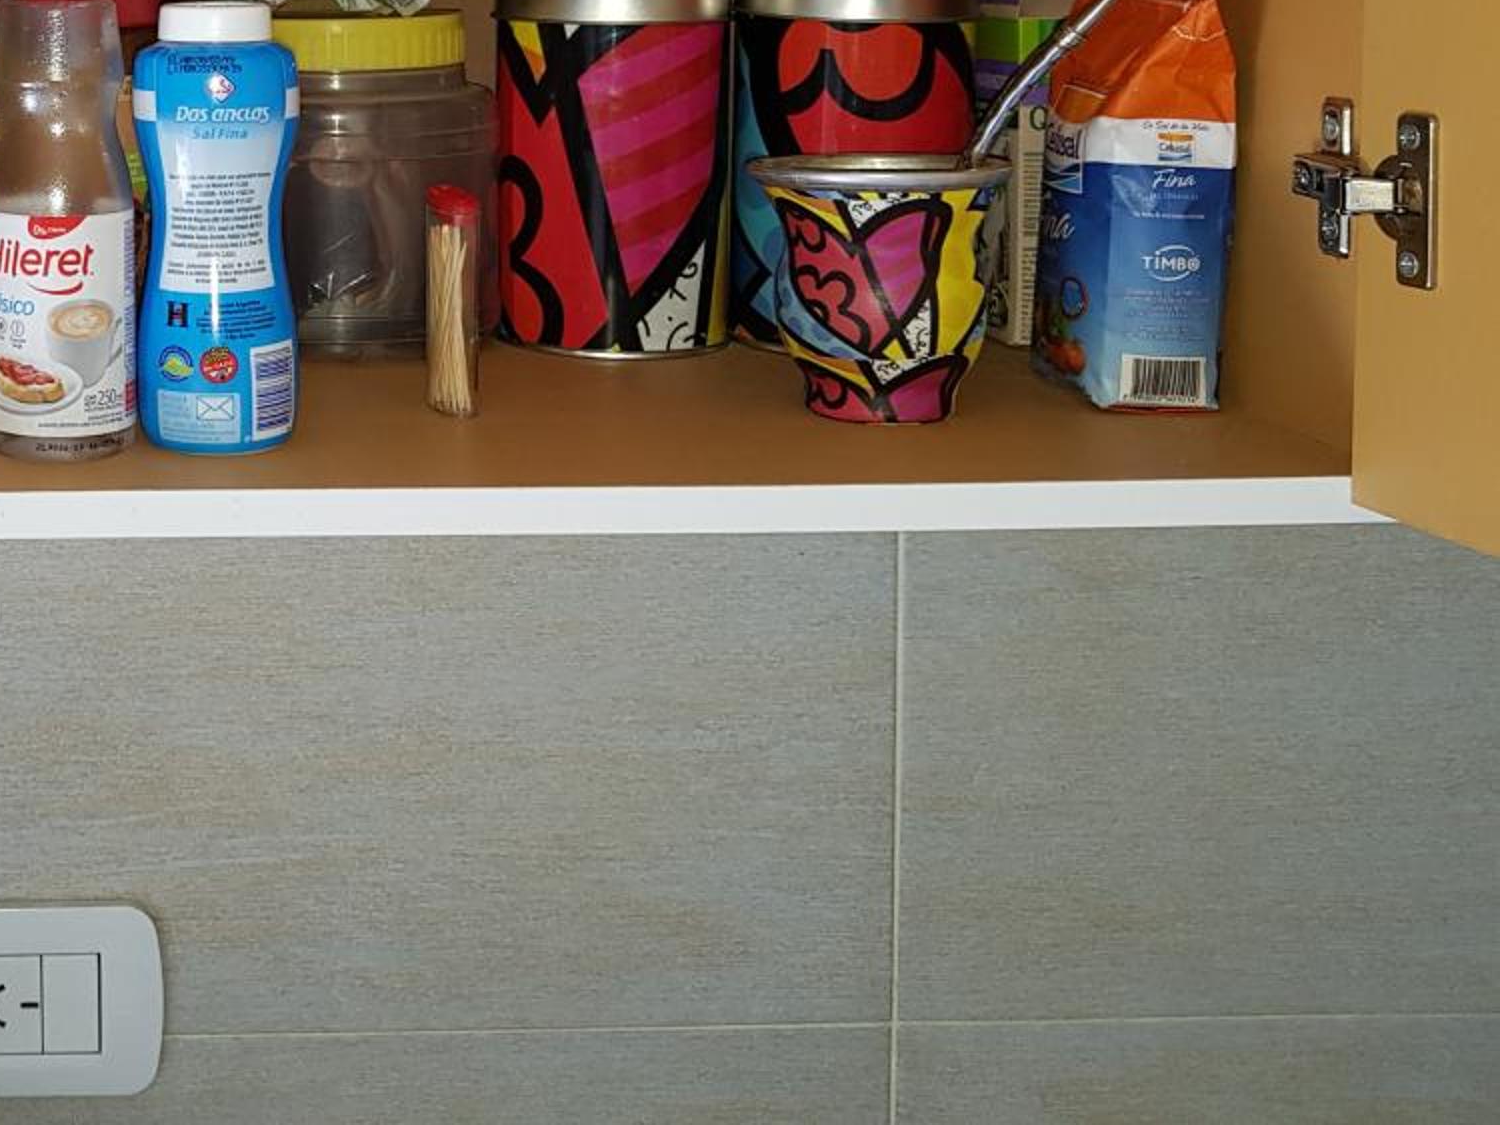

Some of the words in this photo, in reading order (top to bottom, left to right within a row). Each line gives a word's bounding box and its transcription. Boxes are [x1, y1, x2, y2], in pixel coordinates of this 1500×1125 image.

[175, 105, 209, 123] Dos
[211, 105, 271, 124] anclas
[1151, 168, 1197, 189] Fina
